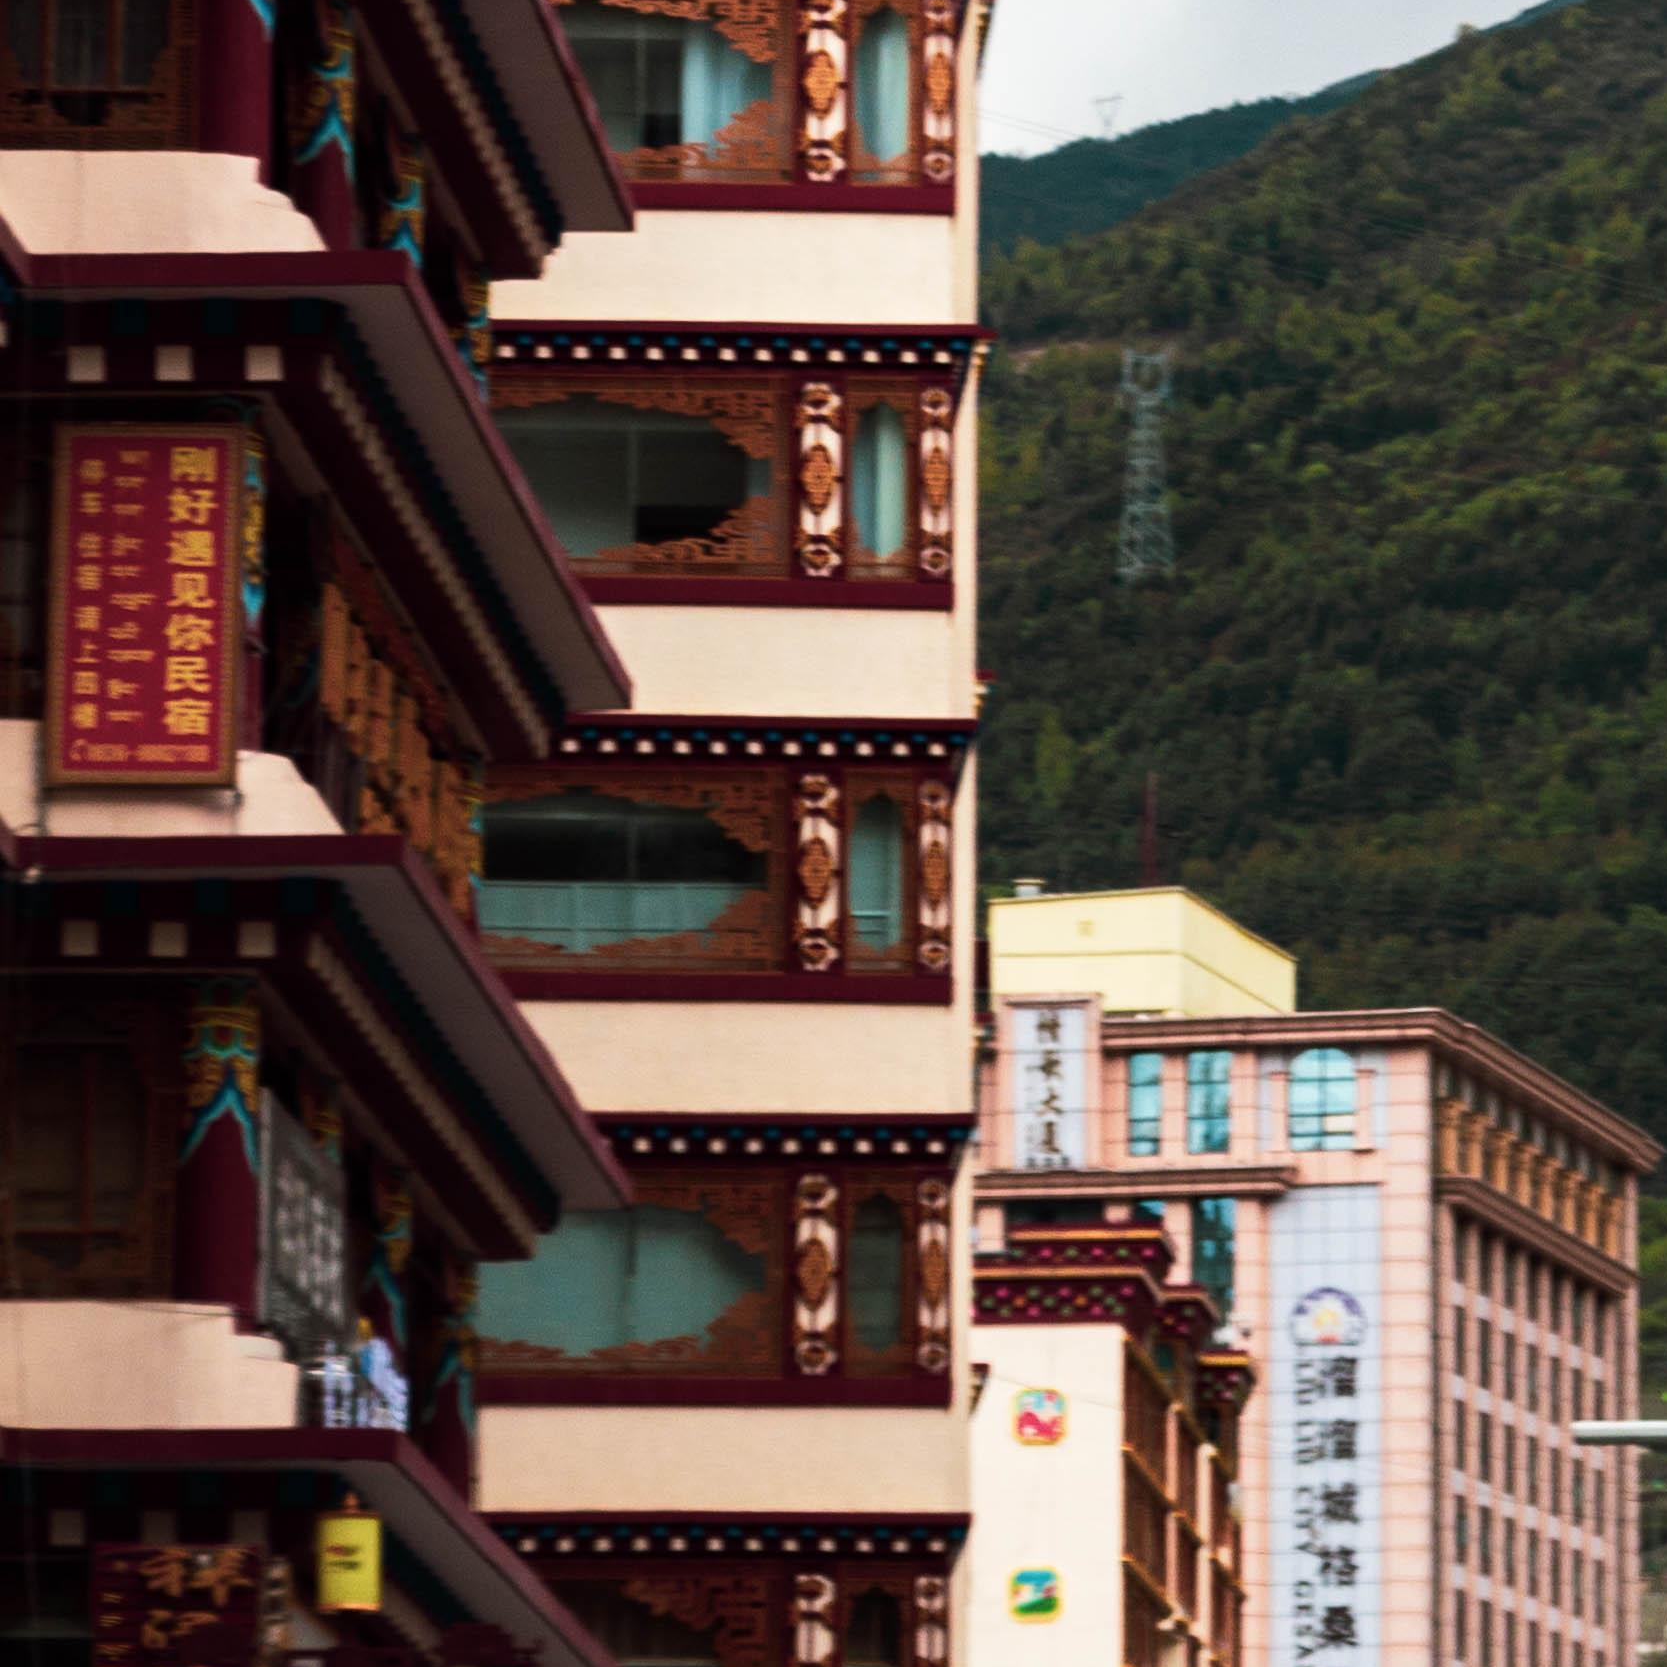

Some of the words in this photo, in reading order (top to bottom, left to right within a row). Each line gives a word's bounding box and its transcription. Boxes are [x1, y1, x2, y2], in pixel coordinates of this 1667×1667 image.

[164, 446, 219, 735] 刚好遇见你民宿
